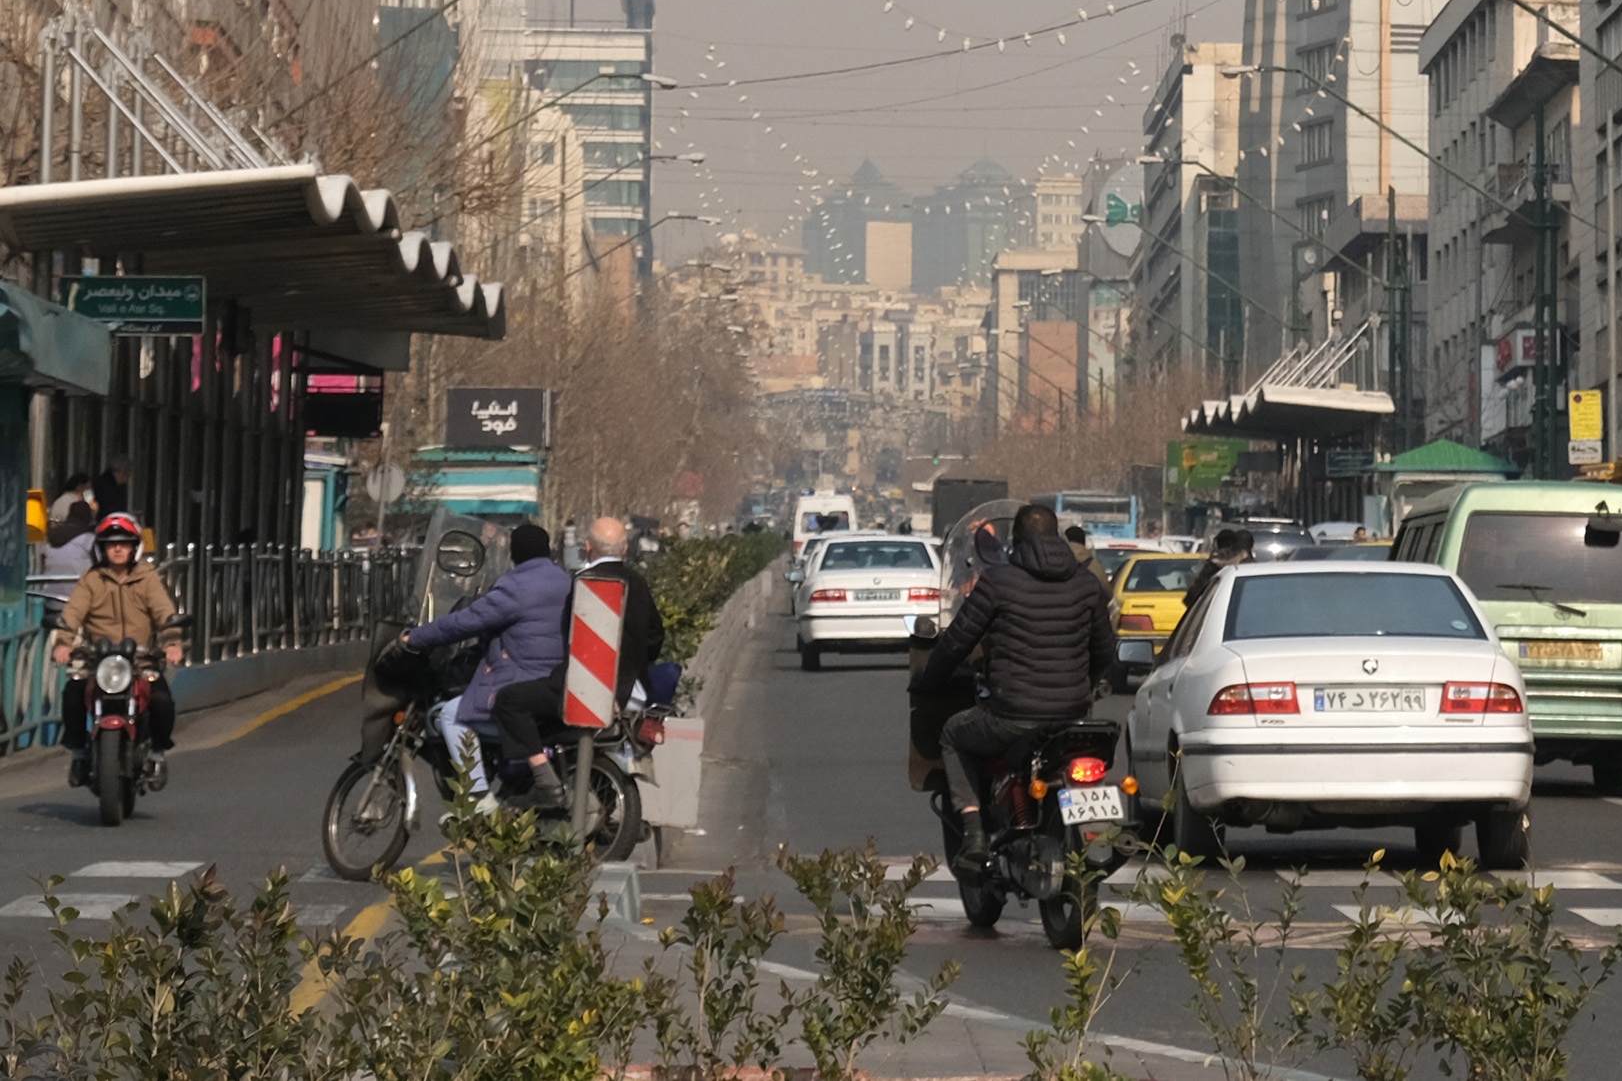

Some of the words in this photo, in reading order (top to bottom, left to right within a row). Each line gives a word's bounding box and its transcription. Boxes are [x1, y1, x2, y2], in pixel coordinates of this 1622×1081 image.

[82, 283, 135, 302] ولیعصر
[138, 284, 182, 301] میدان
[481, 416, 518, 436] فود
[1080, 789, 1111, 803] ۱۵۸
[1068, 804, 1119, 820] ۸۶۹۱۵
